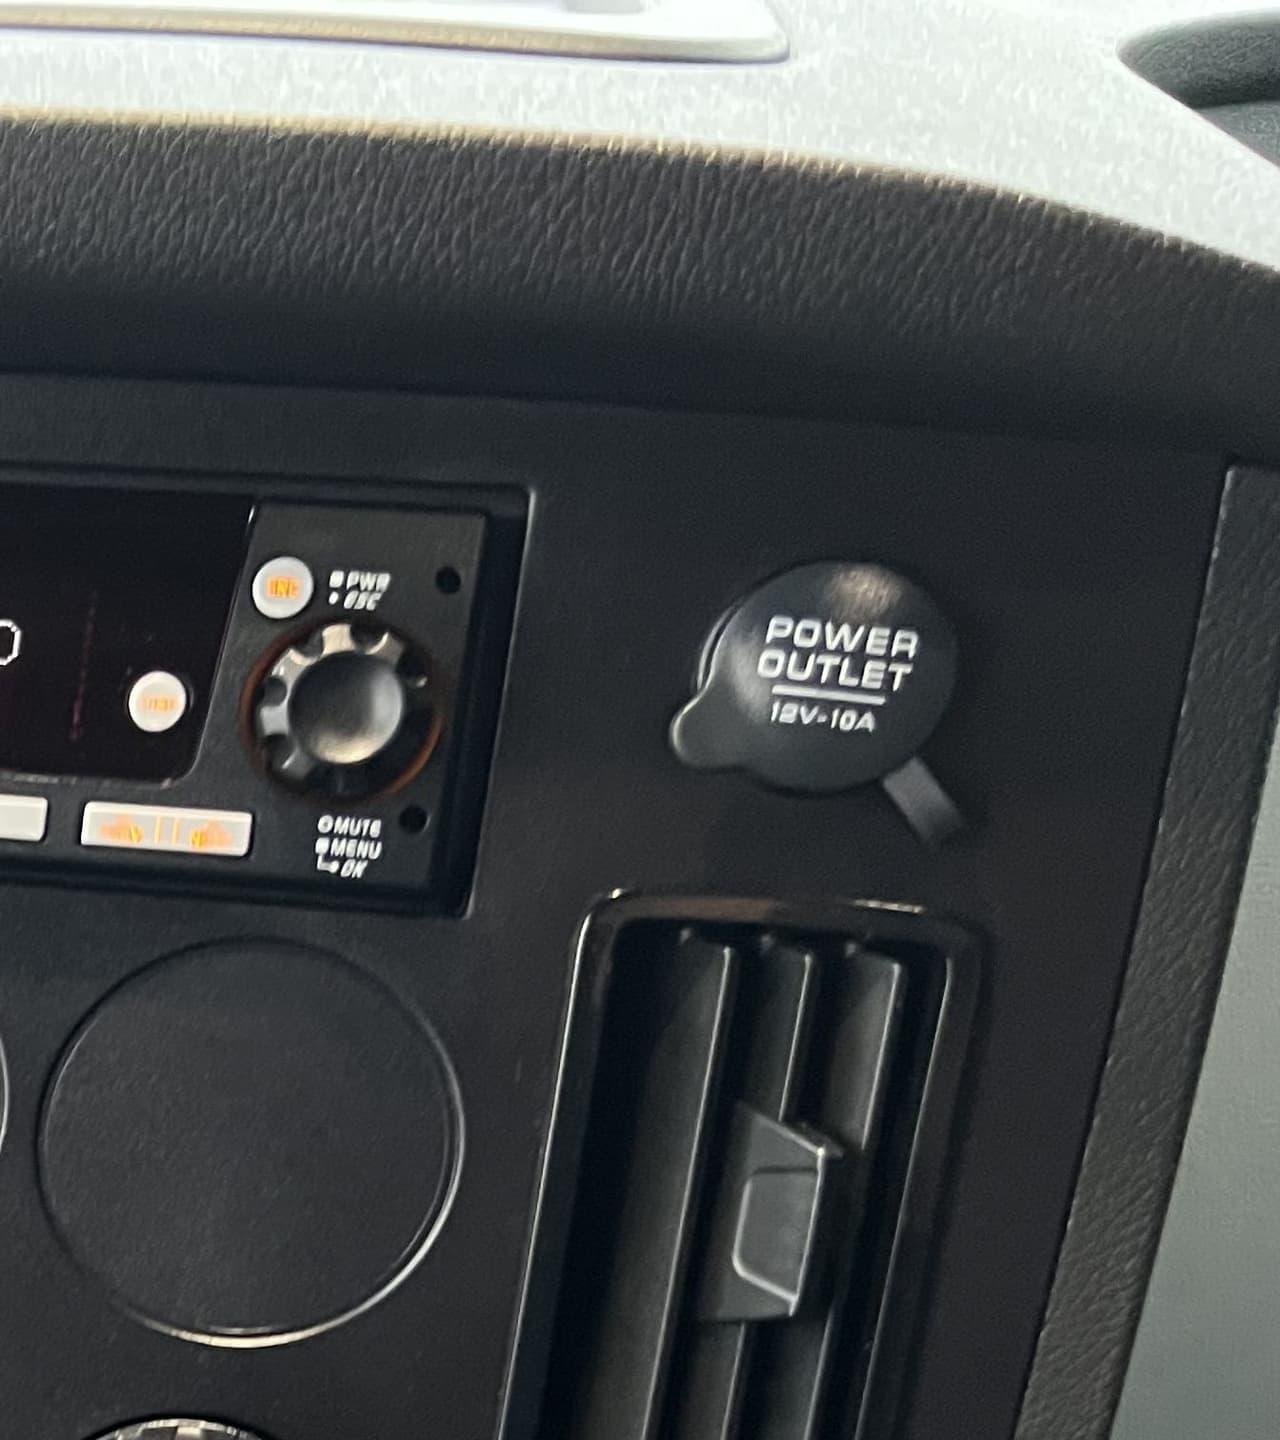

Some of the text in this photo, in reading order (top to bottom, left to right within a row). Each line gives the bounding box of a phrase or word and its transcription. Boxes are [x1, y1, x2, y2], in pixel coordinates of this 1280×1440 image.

[765, 615, 919, 659] POWER
[757, 649, 914, 692] OUTLET
[770, 701, 877, 735] 12V-10A
[330, 837, 382, 860] MENU
